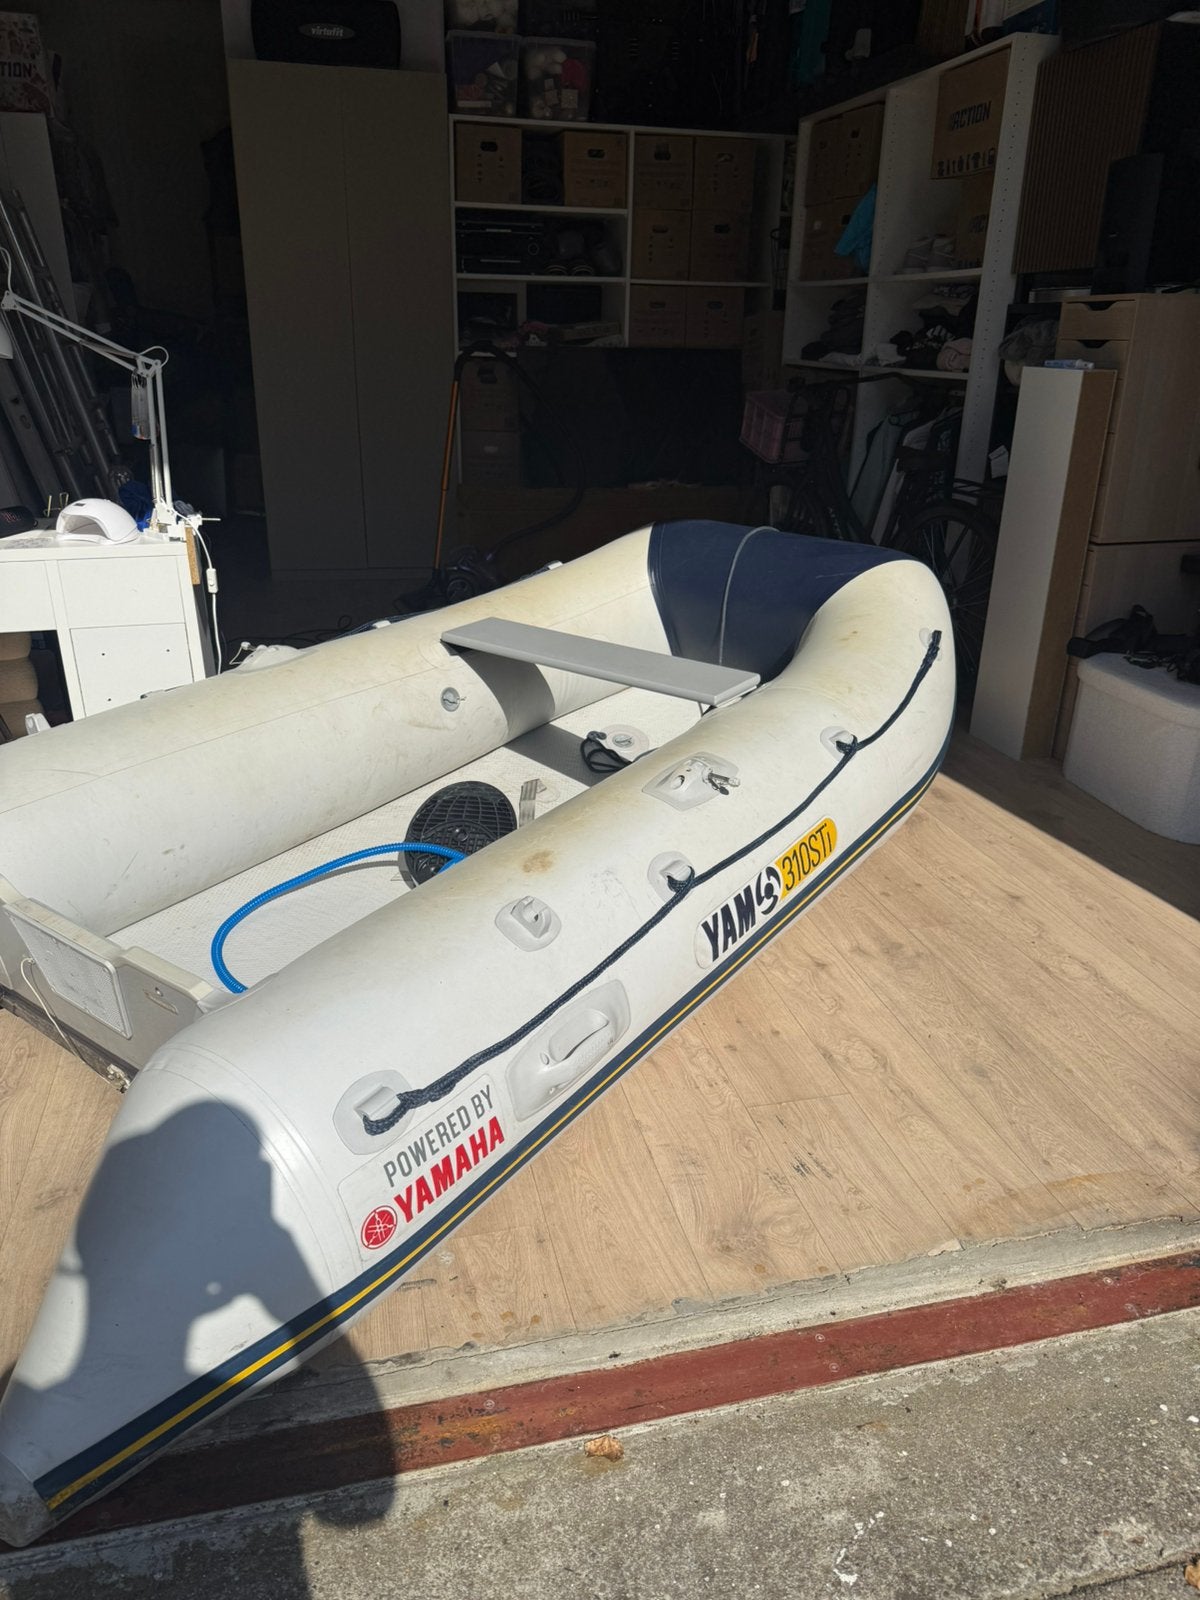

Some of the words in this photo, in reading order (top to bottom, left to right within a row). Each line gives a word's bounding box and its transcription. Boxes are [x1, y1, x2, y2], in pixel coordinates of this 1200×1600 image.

[951, 101, 992, 131] ACTION
[782, 823, 832, 891] 310STi
[383, 1105, 471, 1188] POWERED
[471, 1084, 493, 1119] BY
[394, 1116, 505, 1223] YAMAHA
